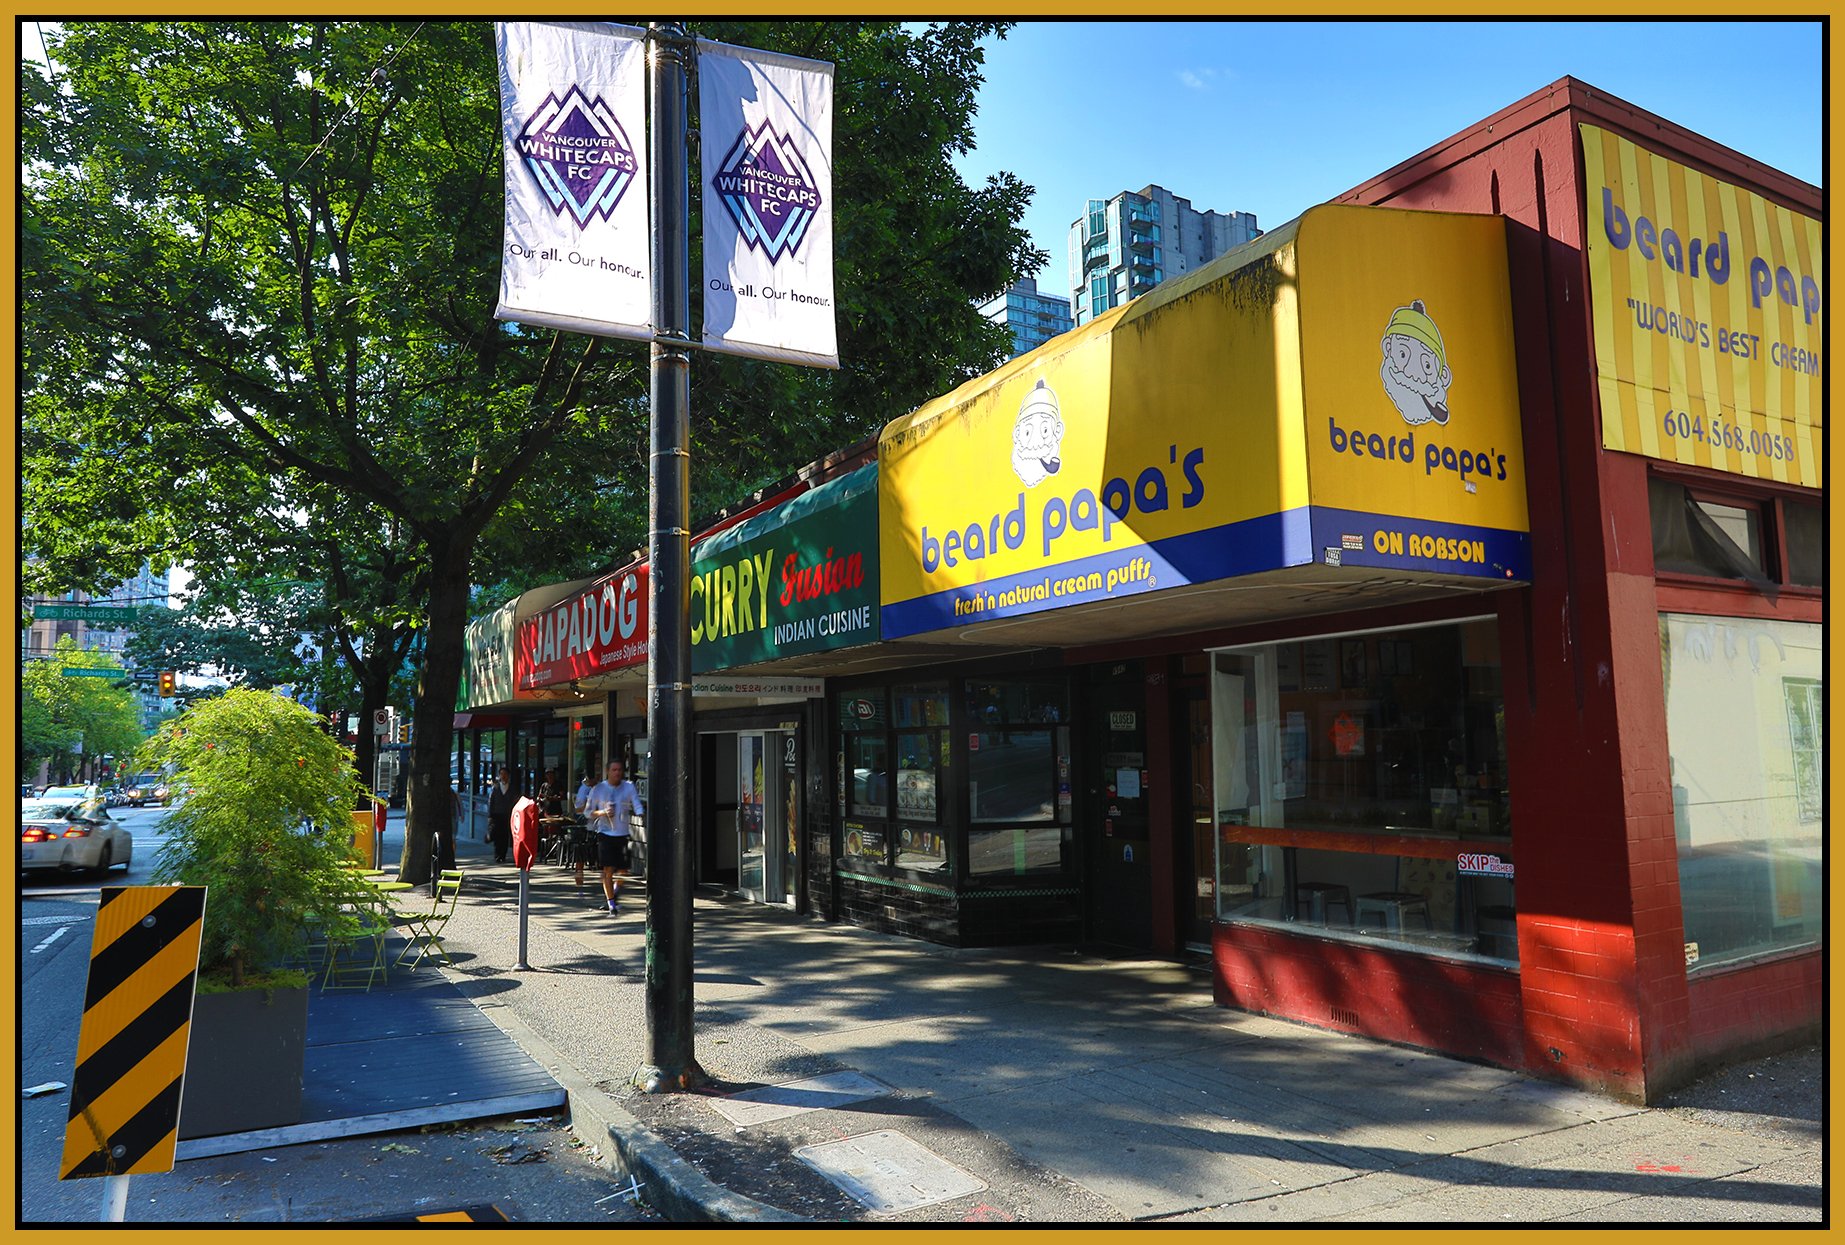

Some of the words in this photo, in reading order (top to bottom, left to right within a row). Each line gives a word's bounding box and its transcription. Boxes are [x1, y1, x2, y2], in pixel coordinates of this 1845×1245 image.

[519, 138, 634, 171] WHITECAPS
[541, 132, 616, 149] VANCOUVER
[567, 165, 592, 181] FC
[739, 166, 802, 187] VANCOUVER
[718, 176, 817, 208] WHITECAPS
[760, 200, 781, 217] FC
[1601, 186, 1731, 285] beard
[509, 243, 536, 260] Our
[540, 249, 562, 263] all.
[567, 250, 596, 268] Our
[737, 284, 758, 298] all.
[761, 286, 788, 301] Our
[790, 289, 831, 307] honour.
[1719, 327, 1760, 361] BEST
[1771, 342, 1820, 378] CREAM
[1328, 416, 1415, 464] beard
[1424, 442, 1507, 481] papa's
[1663, 409, 1795, 462] 604.568.0058
[921, 492, 1025, 574] beard
[1042, 444, 1204, 557] papa's
[1373, 530, 1403, 556] ON
[1409, 535, 1485, 563] ROBSON
[691, 549, 774, 646] CURRY
[780, 546, 864, 607] Fusion
[955, 588, 996, 616] fresh'n
[998, 574, 1051, 608] natural
[1053, 570, 1103, 597] cream
[1106, 556, 1151, 590] puffs
[63, 608, 110, 619] Richards
[113, 609, 128, 619] St.
[533, 573, 638, 667] JAPADOG
[774, 617, 815, 646] INDIAN
[818, 605, 870, 636] CUISINE
[600, 648, 622, 668] Japanese
[622, 641, 637, 661] Style
[710, 683, 733, 693] Cuisine
[1112, 713, 1134, 724] CLOSED
[1459, 855, 1489, 871] SKIP
[1490, 864, 1514, 873] DISHES
